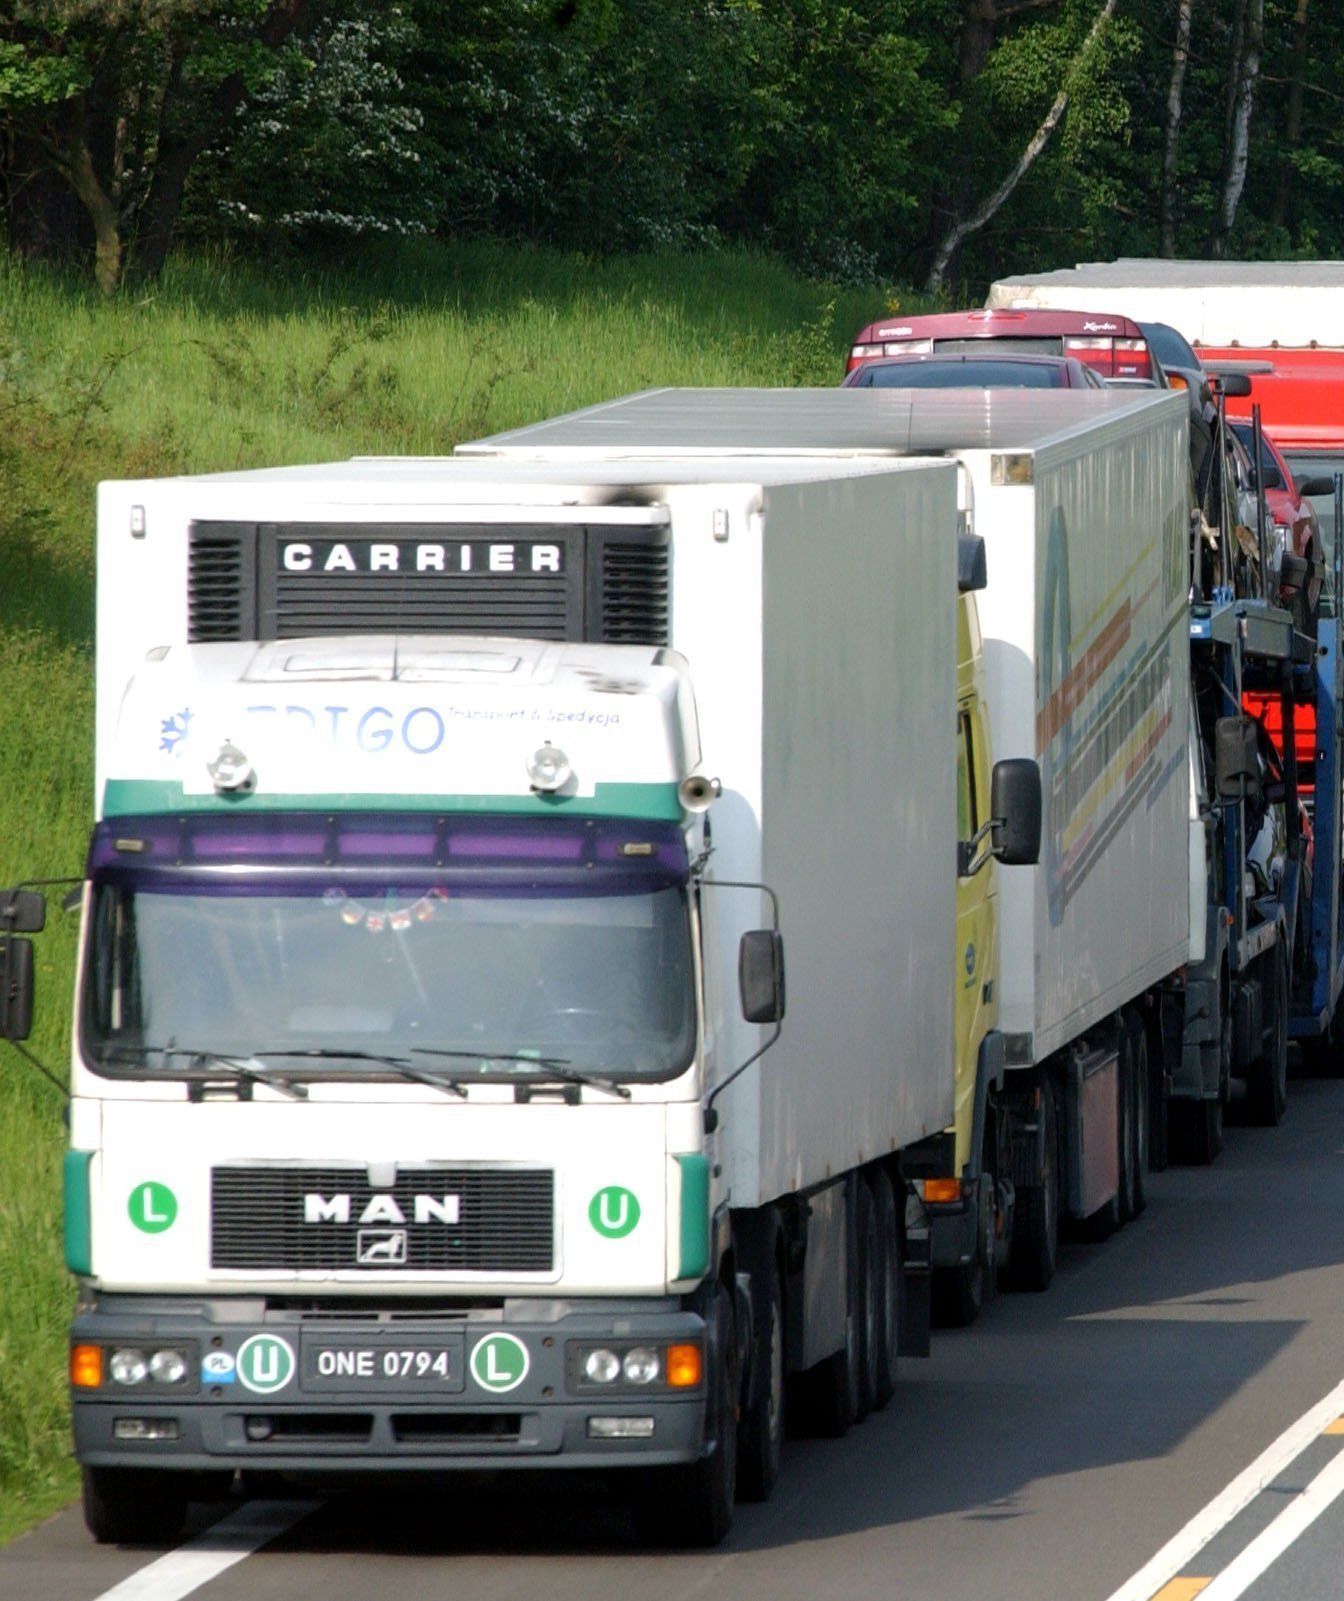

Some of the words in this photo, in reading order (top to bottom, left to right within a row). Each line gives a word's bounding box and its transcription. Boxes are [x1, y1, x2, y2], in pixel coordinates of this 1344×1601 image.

[283, 543, 560, 571] CARRIER
[142, 1187, 168, 1222] L
[303, 1193, 460, 1224] MAN
[599, 1193, 629, 1229] U
[210, 1356, 229, 1370] PL
[252, 1345, 279, 1382] U
[318, 1351, 375, 1377] ONE
[383, 1351, 449, 1377] 0794
[486, 1344, 512, 1381] L
